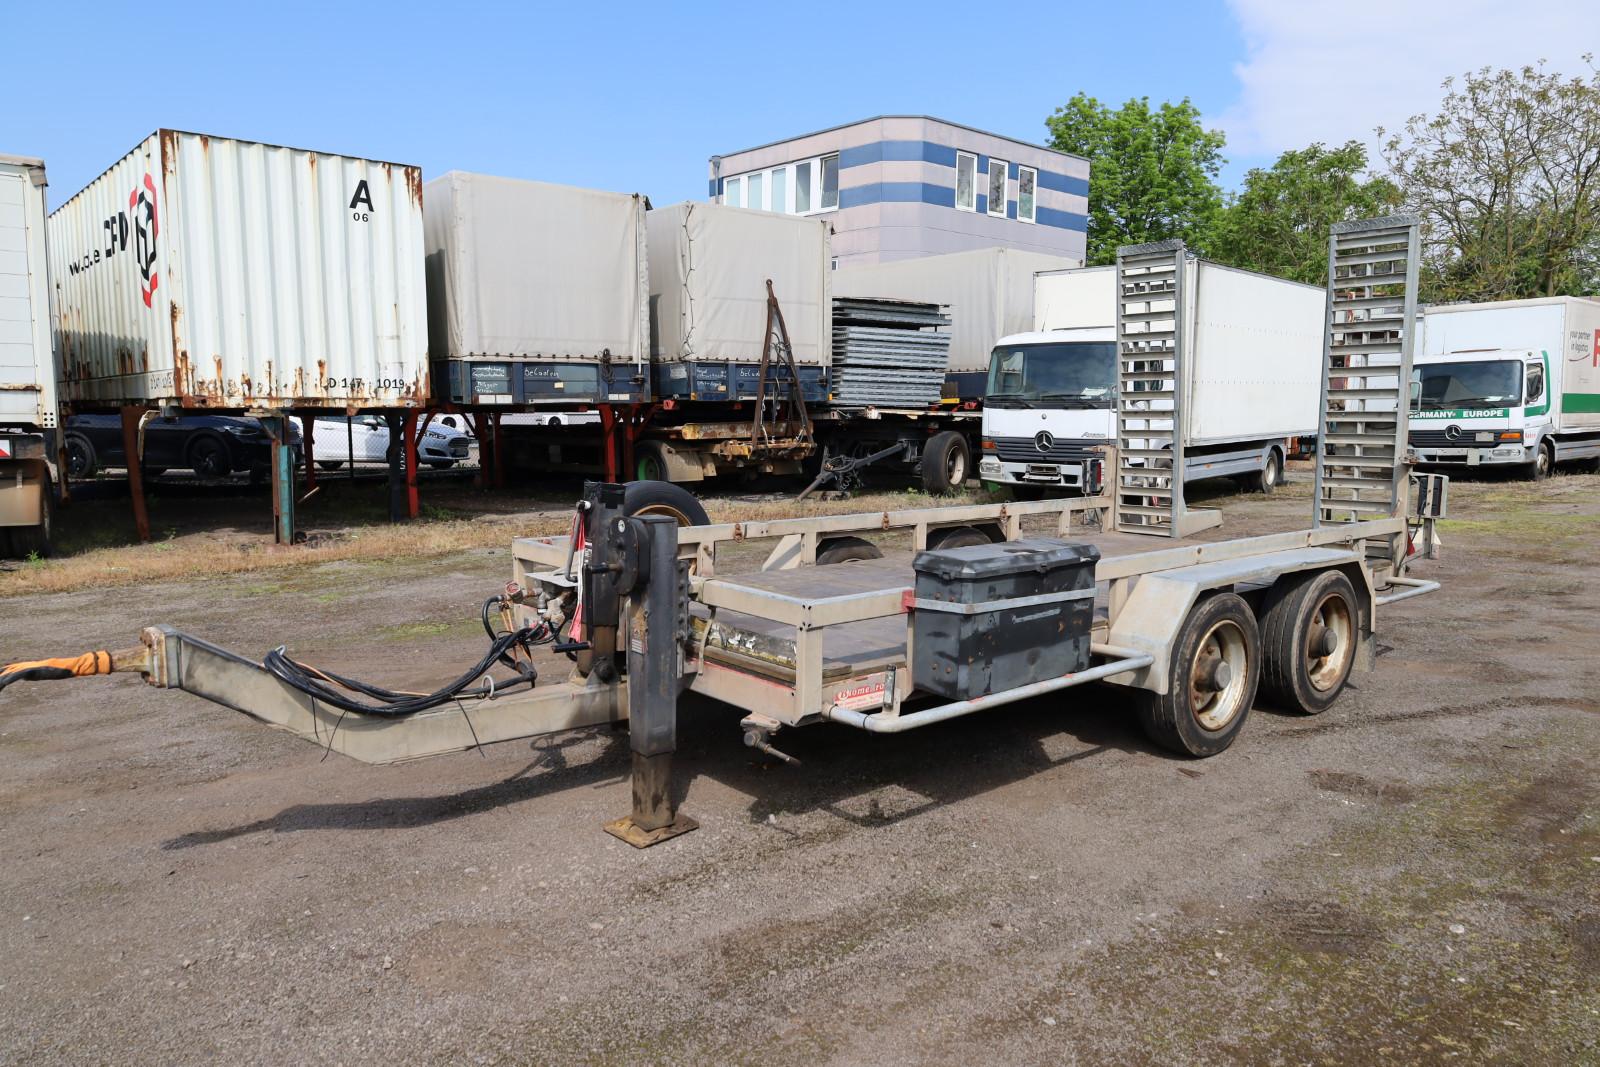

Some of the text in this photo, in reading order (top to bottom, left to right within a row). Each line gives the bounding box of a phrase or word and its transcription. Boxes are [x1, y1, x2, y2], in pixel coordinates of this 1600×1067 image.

[349, 180, 374, 212] A
[353, 212, 369, 222] 06
[328, 378, 337, 388] D
[377, 378, 405, 389] 1019
[1463, 409, 1504, 418] EUROPE
